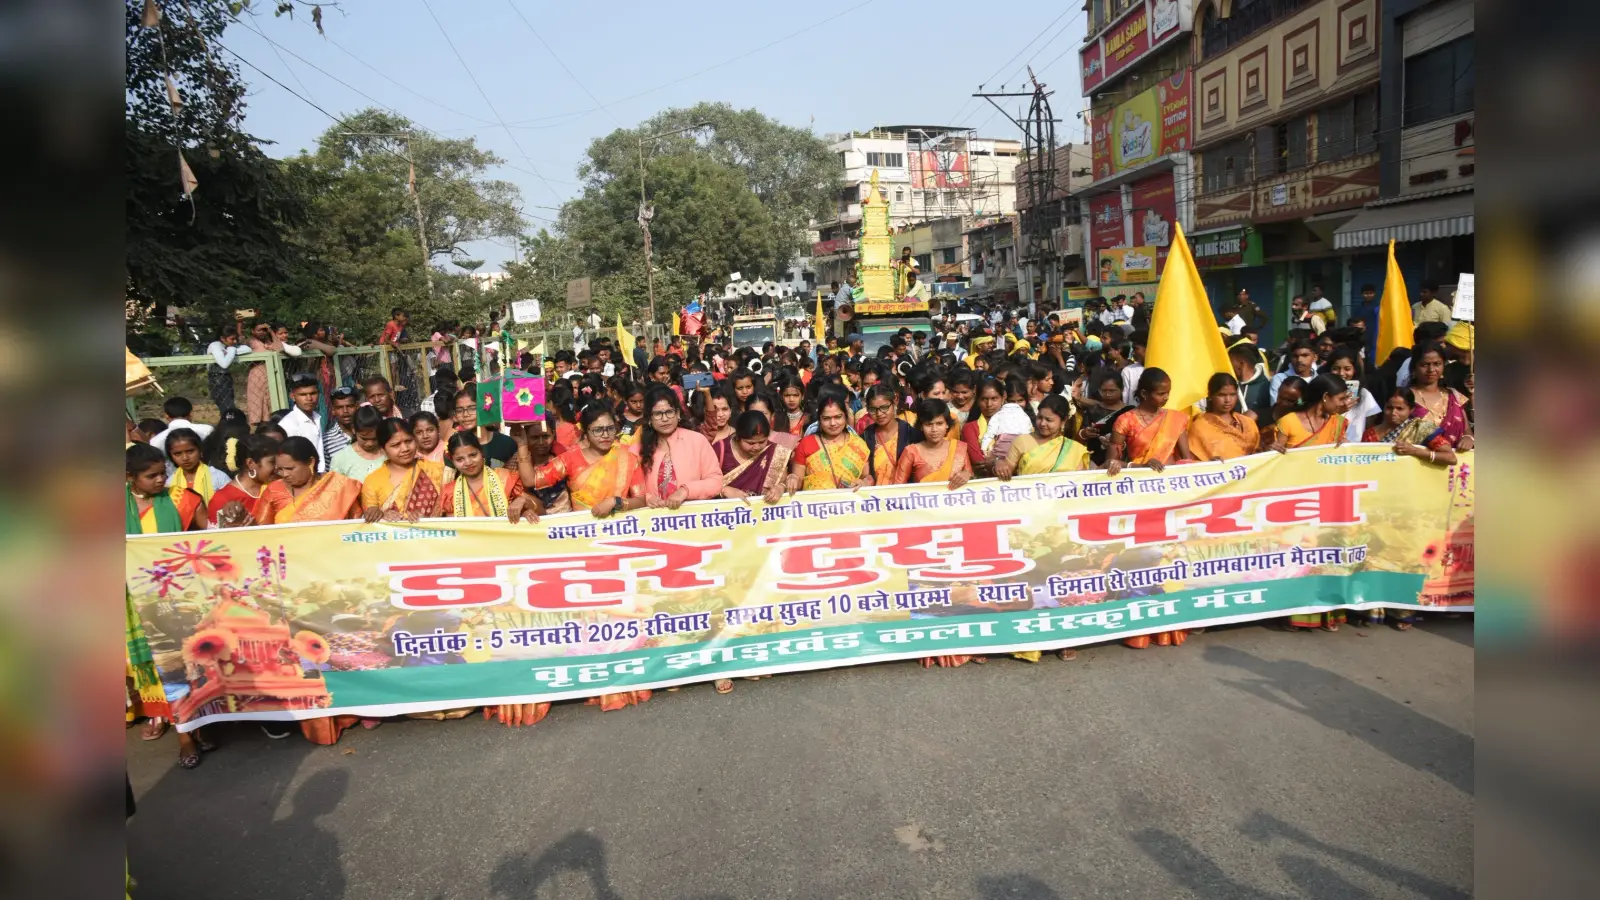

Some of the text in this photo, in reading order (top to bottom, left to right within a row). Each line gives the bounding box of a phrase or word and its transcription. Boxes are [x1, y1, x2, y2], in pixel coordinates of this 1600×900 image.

[1164, 96, 1188, 114] EVENING
[1165, 110, 1187, 126] TUITION
[1317, 455, 1353, 464] जोहार
[548, 465, 1247, 539] अपना माटी, अपना संस्कृति, अपनी पहचान को स्थापित करने के लिए पिछले साल की तरह इस साल भी
[342, 531, 389, 543] जोहार
[388, 484, 1369, 609] डहरे टुसु परब
[394, 630, 468, 655] दिनांक
[491, 631, 504, 648] 5
[509, 622, 582, 647] जनवरी
[588, 621, 639, 642] 2025
[644, 612, 710, 636] रविवार
[725, 604, 774, 625] समय
[778, 600, 822, 625] सुबह
[828, 594, 851, 614] 10
[857, 590, 889, 612] बजे
[894, 588, 951, 610] प्रारम्भ
[977, 583, 1028, 602] स्थान
[1050, 574, 1105, 597] डिमना
[1109, 570, 1125, 590] से
[1130, 561, 1188, 588] साकची
[1193, 552, 1286, 578] आमबागान
[1290, 545, 1342, 567] मैदान
[1347, 545, 1367, 563] तक
[663, 631, 864, 670] झाड़खंड
[876, 621, 998, 645] कला
[1012, 599, 1181, 635] संस्कृति
[1192, 587, 1268, 608] मंच
